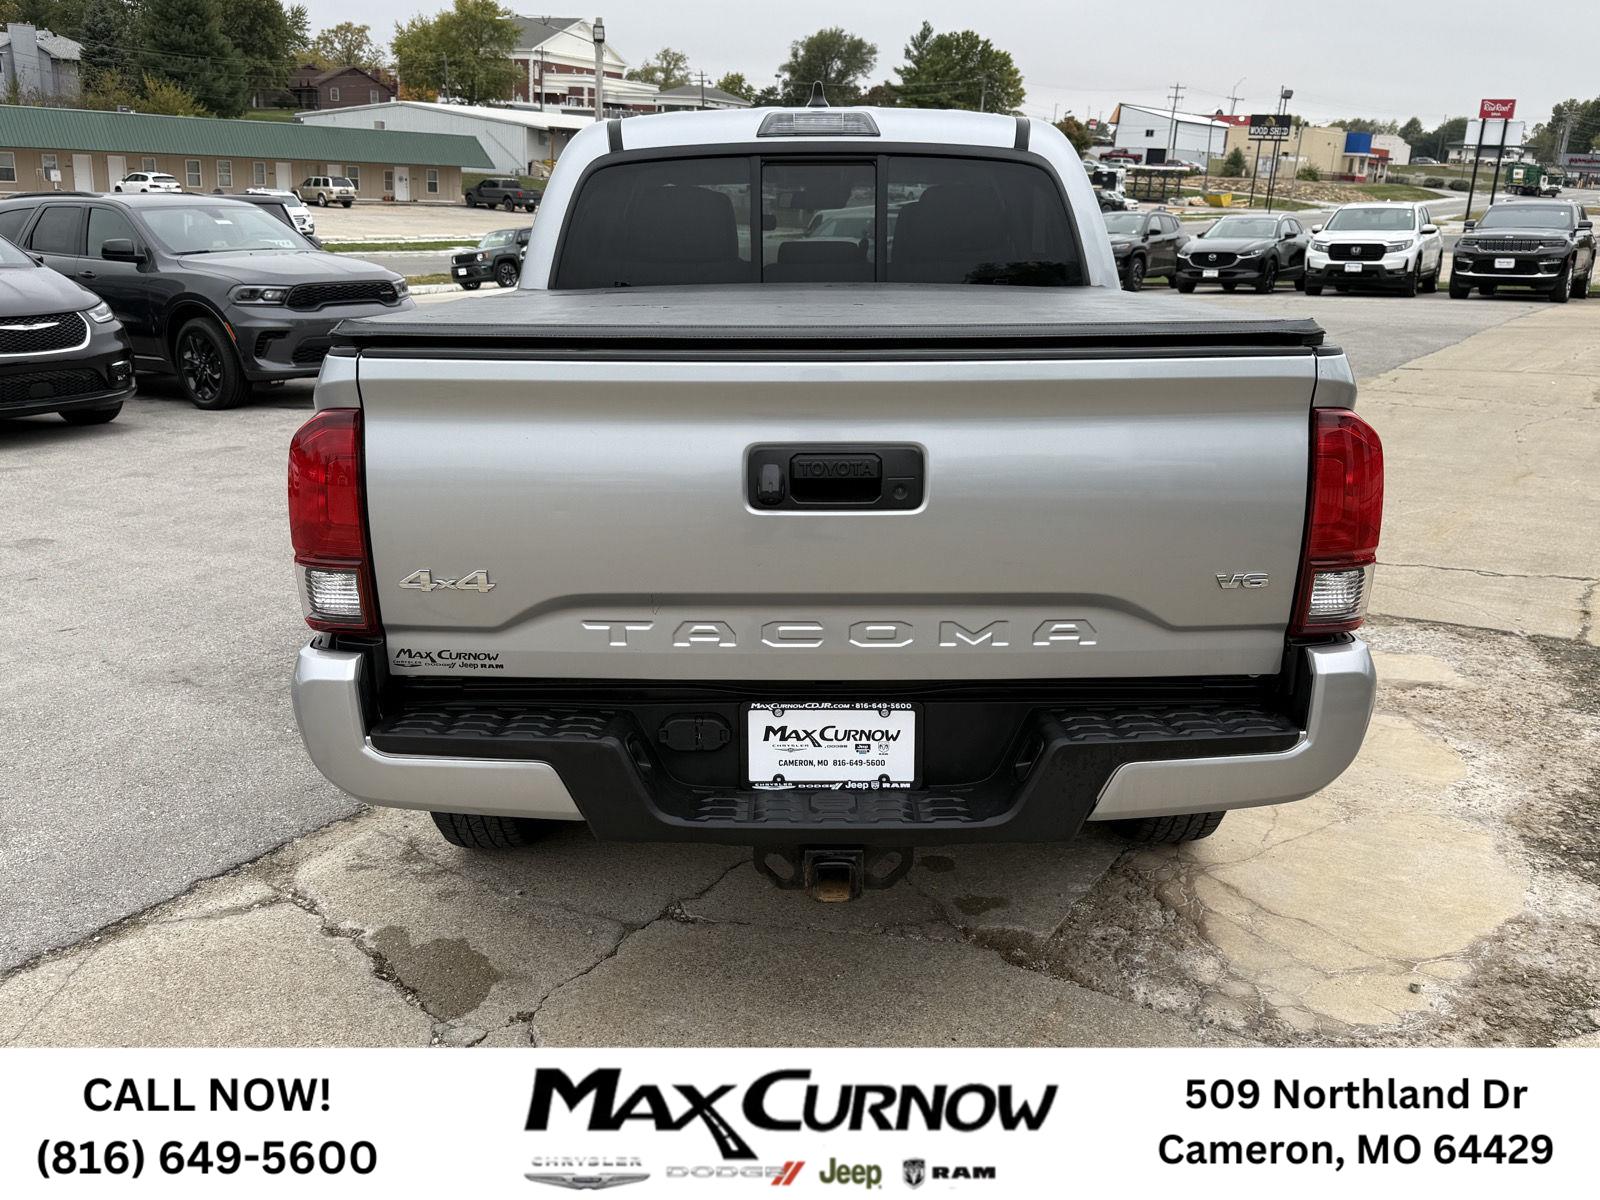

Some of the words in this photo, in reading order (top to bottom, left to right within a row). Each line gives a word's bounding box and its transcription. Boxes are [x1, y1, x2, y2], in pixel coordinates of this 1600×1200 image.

[799, 461, 876, 477] TOYOTA
[399, 569, 496, 593] 4x4
[1214, 572, 1270, 590] V6
[581, 618, 1098, 648] TACOMA
[396, 648, 437, 663] MAX
[437, 649, 499, 661] CURNOW
[458, 661, 479, 669] Jeep
[763, 725, 822, 747] MAX
[819, 725, 901, 742] CURNOW
[778, 759, 816, 768] CAMERON,
[817, 759, 829, 767] MO
[832, 759, 886, 767] 816-649-5600
[845, 780, 869, 790] Jeep
